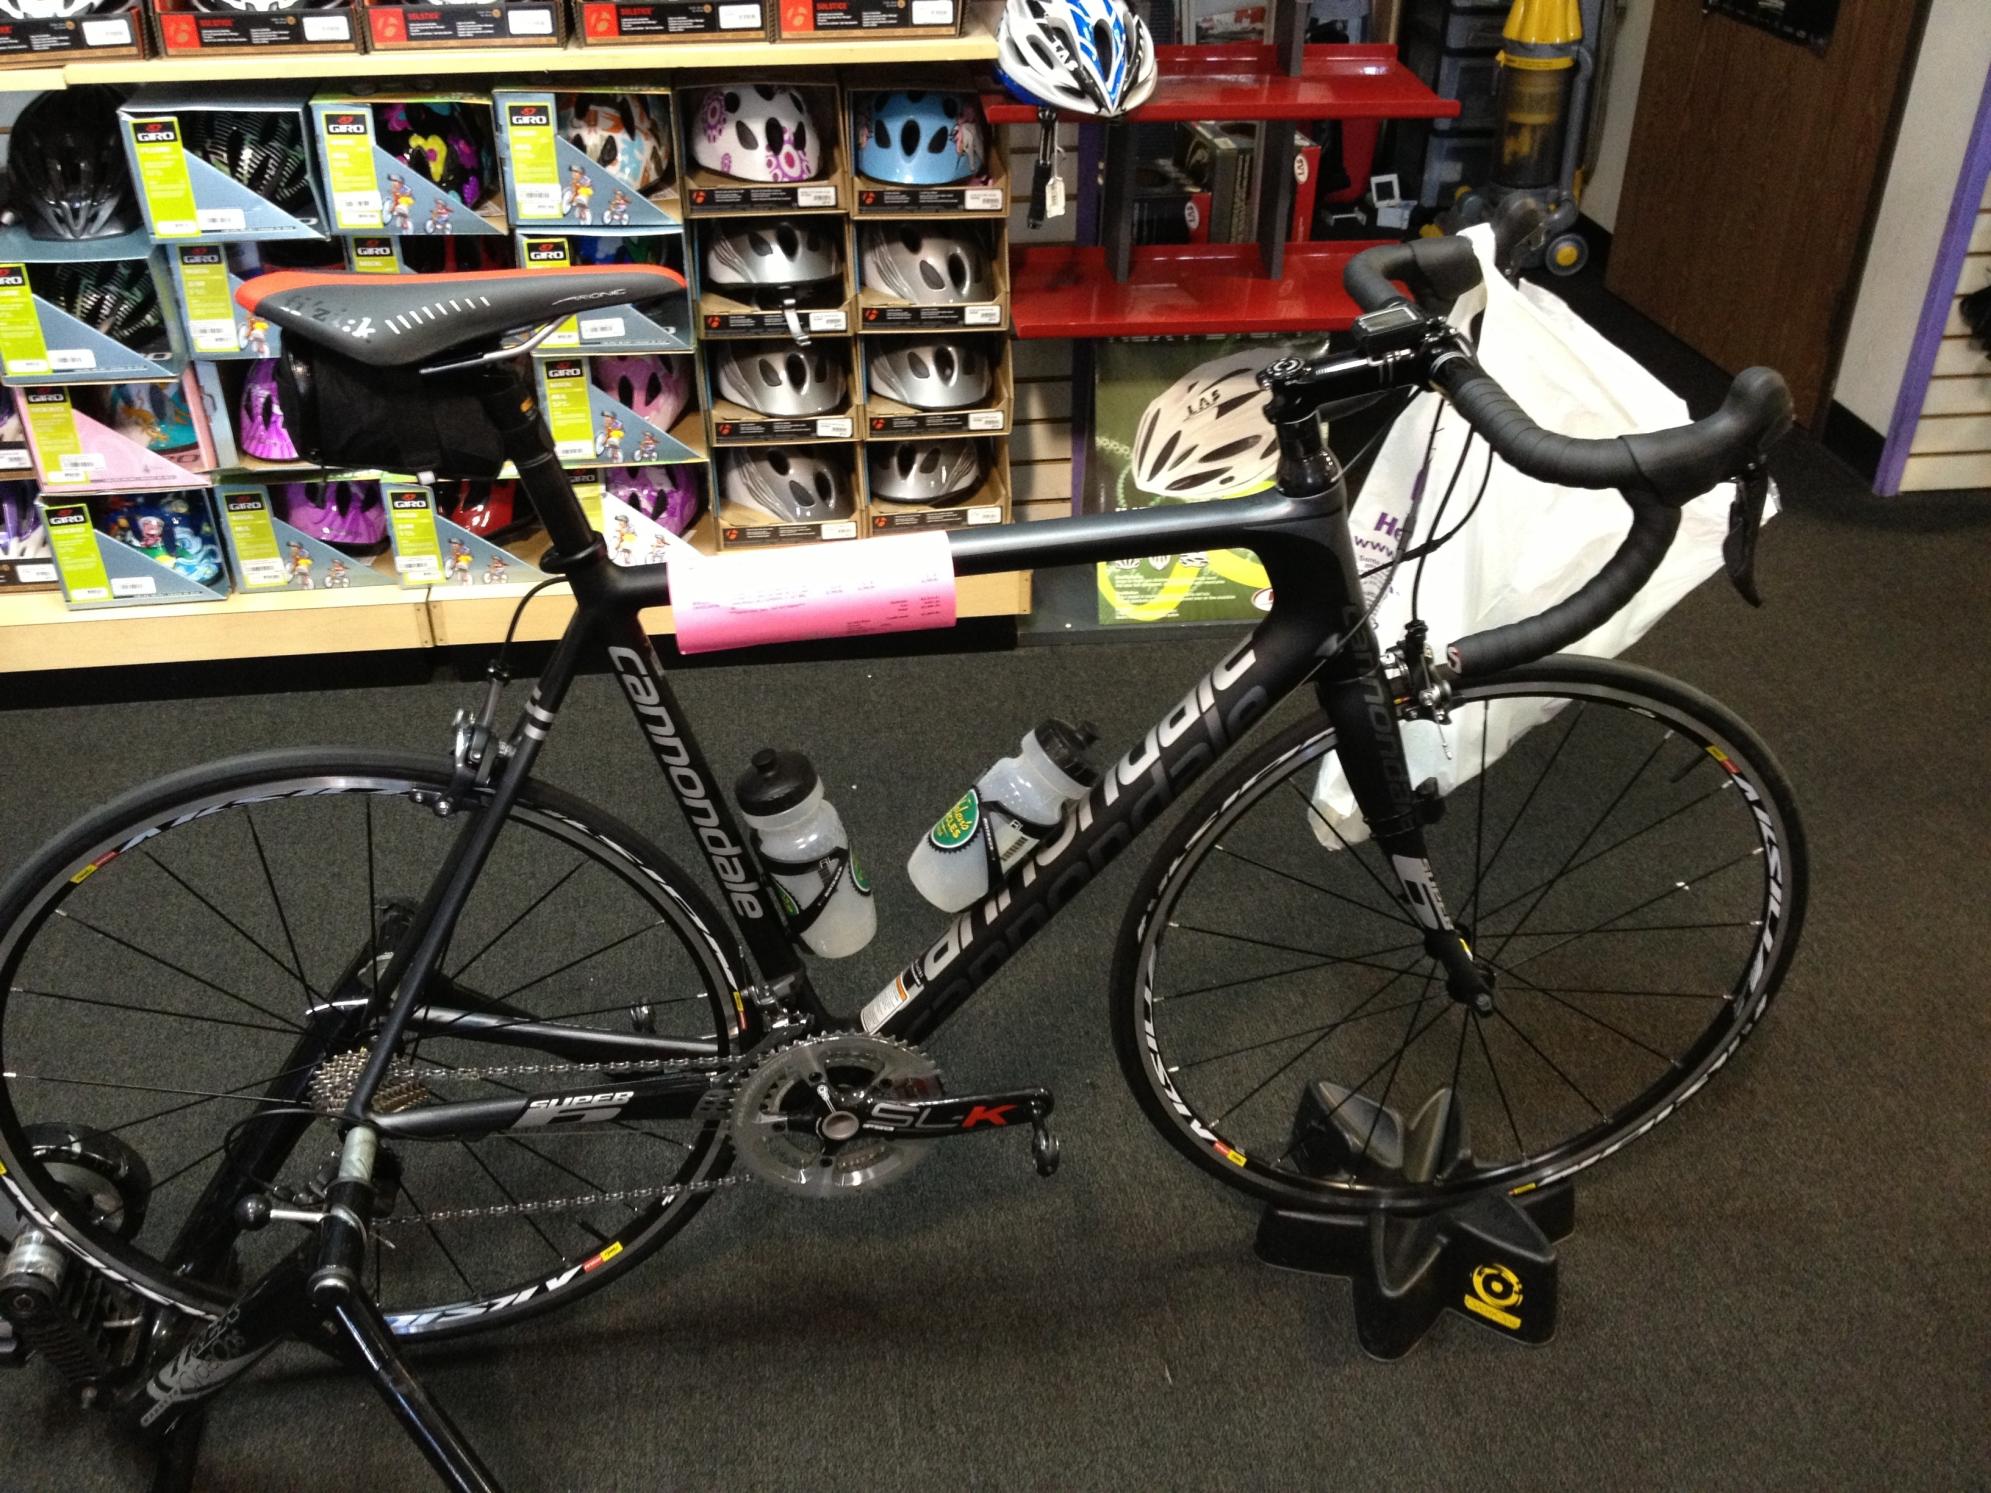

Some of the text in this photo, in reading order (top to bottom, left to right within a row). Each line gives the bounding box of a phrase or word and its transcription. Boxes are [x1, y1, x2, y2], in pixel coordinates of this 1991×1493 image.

[512, 115, 547, 125] GIRO
[328, 124, 365, 133] GIRO
[137, 131, 175, 142] GIRO
[356, 247, 391, 255] GIRO
[530, 251, 564, 260] GIRO
[183, 255, 219, 263] GIRO
[0, 276, 23, 287] RO
[548, 368, 581, 378] GIRO
[28, 393, 64, 403] GIRO
[229, 502, 262, 511] GIRO
[394, 500, 427, 508] GIRO
[49, 515, 85, 525] GIRO
[608, 646, 763, 920] cannondale
[903, 633, 1257, 1009] aondale
[529, 1091, 635, 1109] SUPER
